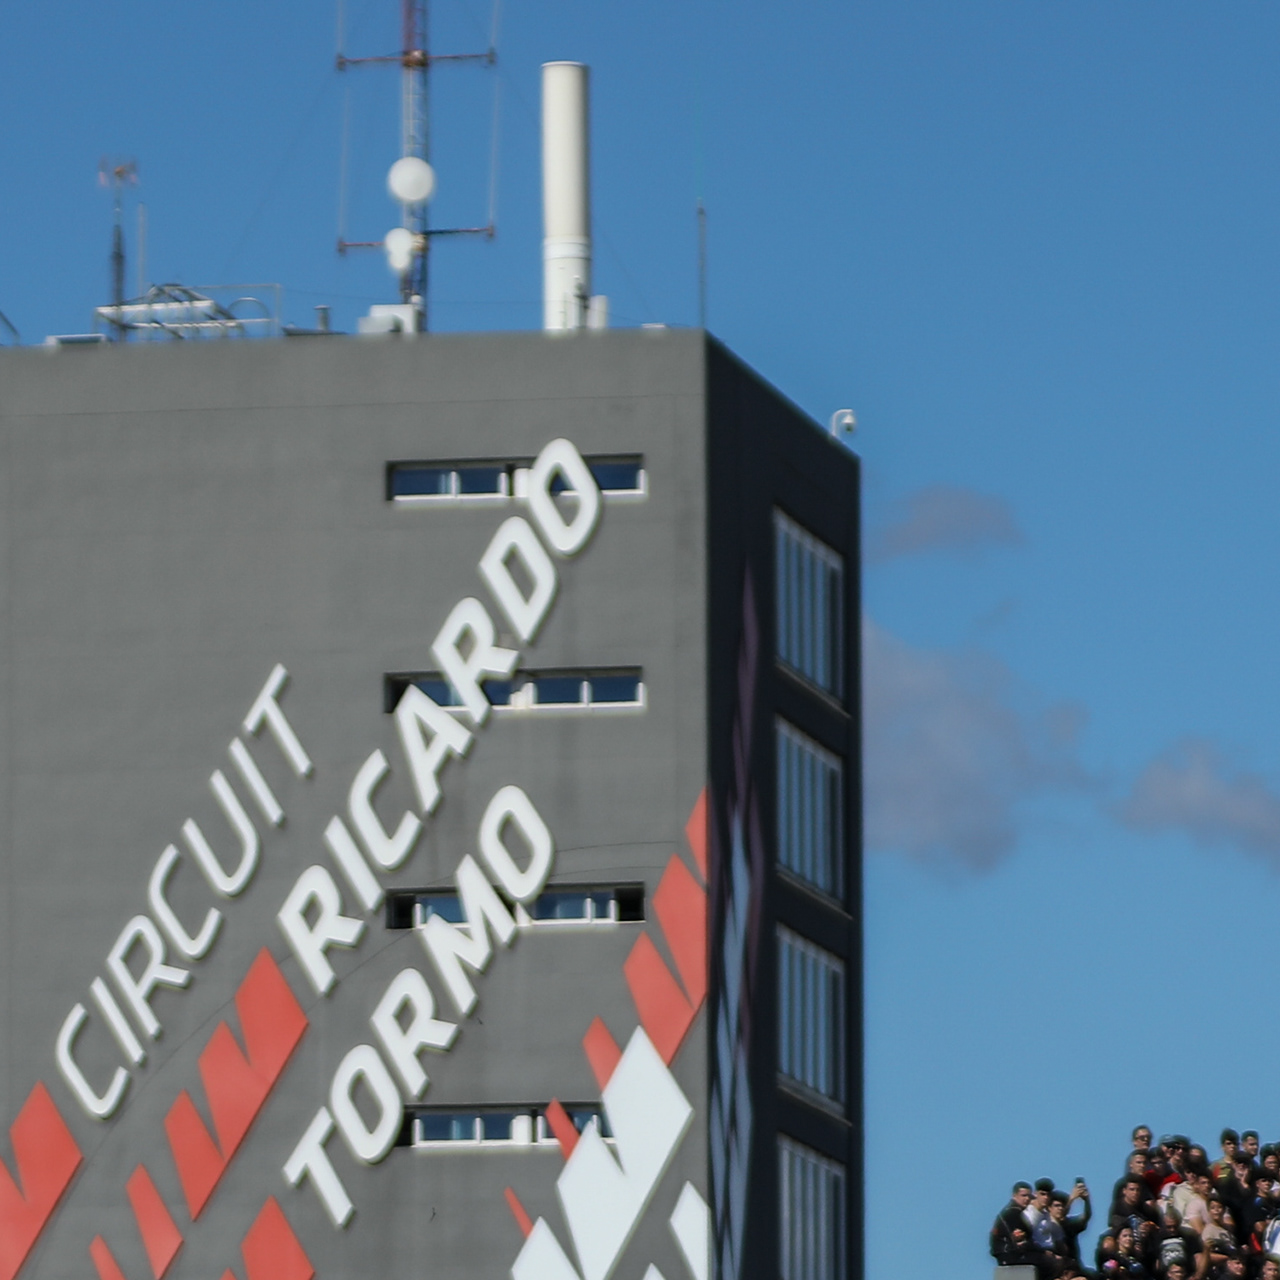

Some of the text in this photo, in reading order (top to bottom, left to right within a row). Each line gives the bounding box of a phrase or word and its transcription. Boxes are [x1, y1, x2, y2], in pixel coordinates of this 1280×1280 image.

[56, 663, 312, 1119] CIRCUIT
[277, 437, 604, 997] RICARDO
[282, 785, 555, 1228] TORMO
